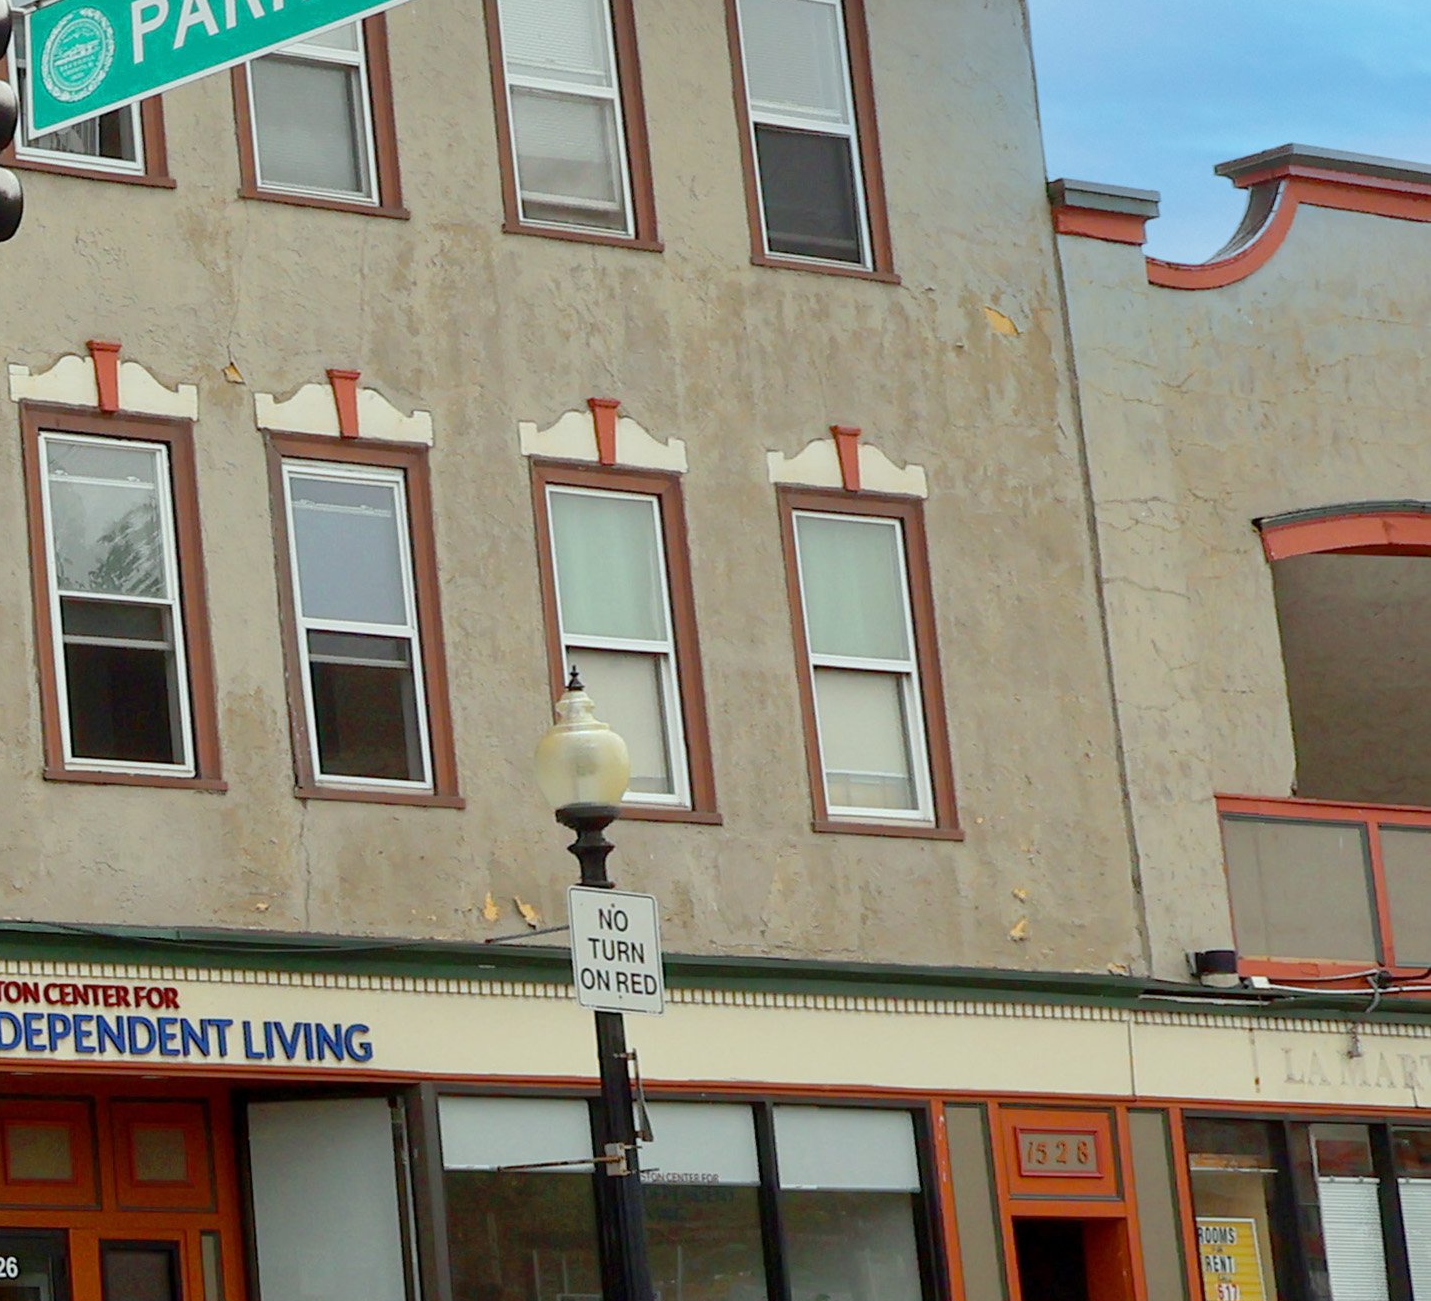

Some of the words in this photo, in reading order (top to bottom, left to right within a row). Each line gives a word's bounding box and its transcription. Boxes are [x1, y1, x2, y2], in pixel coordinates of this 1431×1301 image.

[598, 908, 628, 932] NO
[587, 937, 645, 964] TURN
[581, 968, 610, 991] ON
[616, 972, 657, 996] RED
[43, 982, 132, 1008] CENTER
[134, 986, 180, 1010] FOR
[243, 1020, 373, 1063] LIVING
[666, 1172, 699, 1183] CENTER
[701, 1173, 720, 1184] FOR
[1197, 1227, 1235, 1244] ROOMS
[1206, 1256, 1233, 1271] RENT
